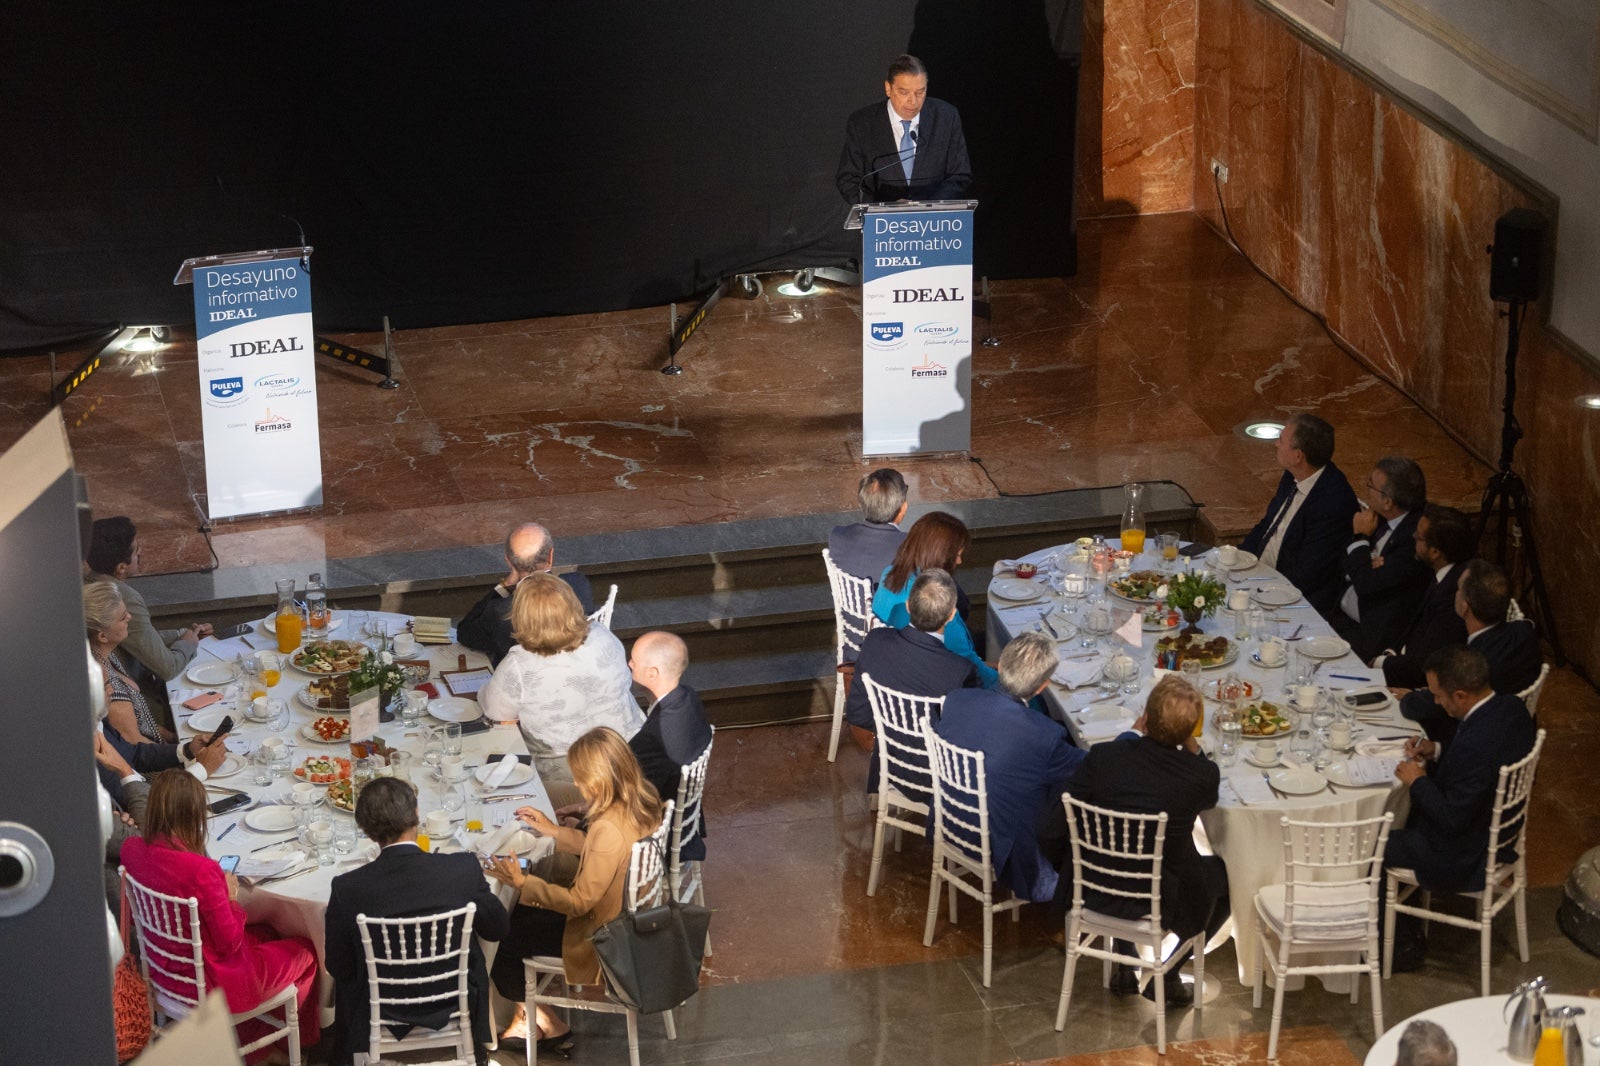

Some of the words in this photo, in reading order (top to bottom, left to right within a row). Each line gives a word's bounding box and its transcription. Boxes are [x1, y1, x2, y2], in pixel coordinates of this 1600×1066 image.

[875, 218, 963, 237] Desayuno
[875, 237, 962, 253] informativo
[875, 256, 921, 267] IDEAL
[206, 266, 297, 288] Desayuno
[208, 285, 298, 307] informativo
[892, 287, 964, 303] IDEAL
[209, 307, 257, 322] IDEAL
[872, 326, 902, 334] PULEVA
[229, 336, 304, 358] IDEAL
[911, 368, 948, 377] Fermasa
[211, 381, 242, 391] PULEVA
[259, 377, 295, 387] LACTALIS
[254, 422, 292, 432] Fermasa
